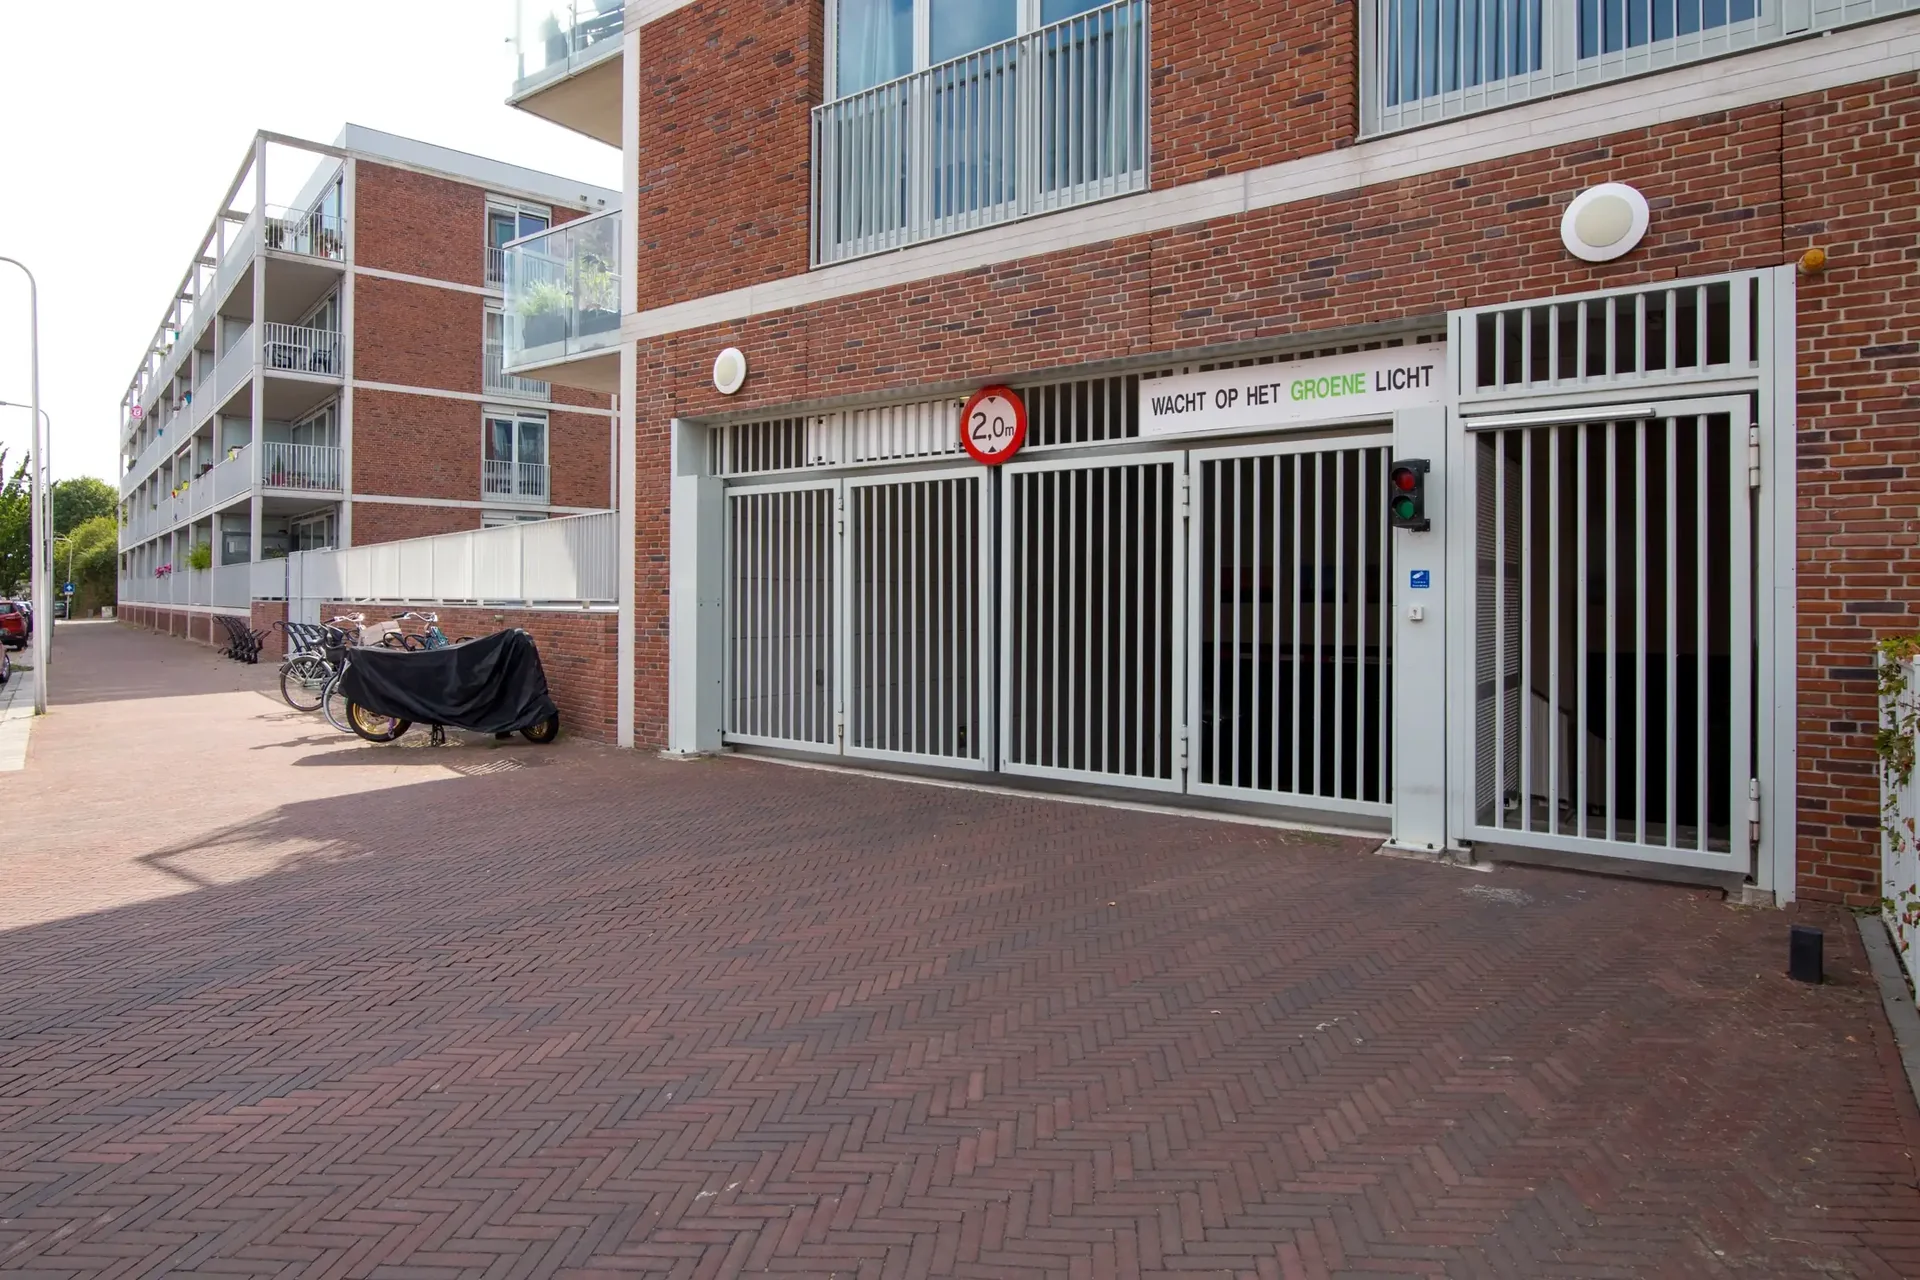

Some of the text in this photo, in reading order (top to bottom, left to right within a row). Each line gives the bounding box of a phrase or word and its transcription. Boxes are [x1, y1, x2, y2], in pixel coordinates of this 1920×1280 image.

[1152, 365, 1434, 416] WACHT OP HET GROENE LICHT
